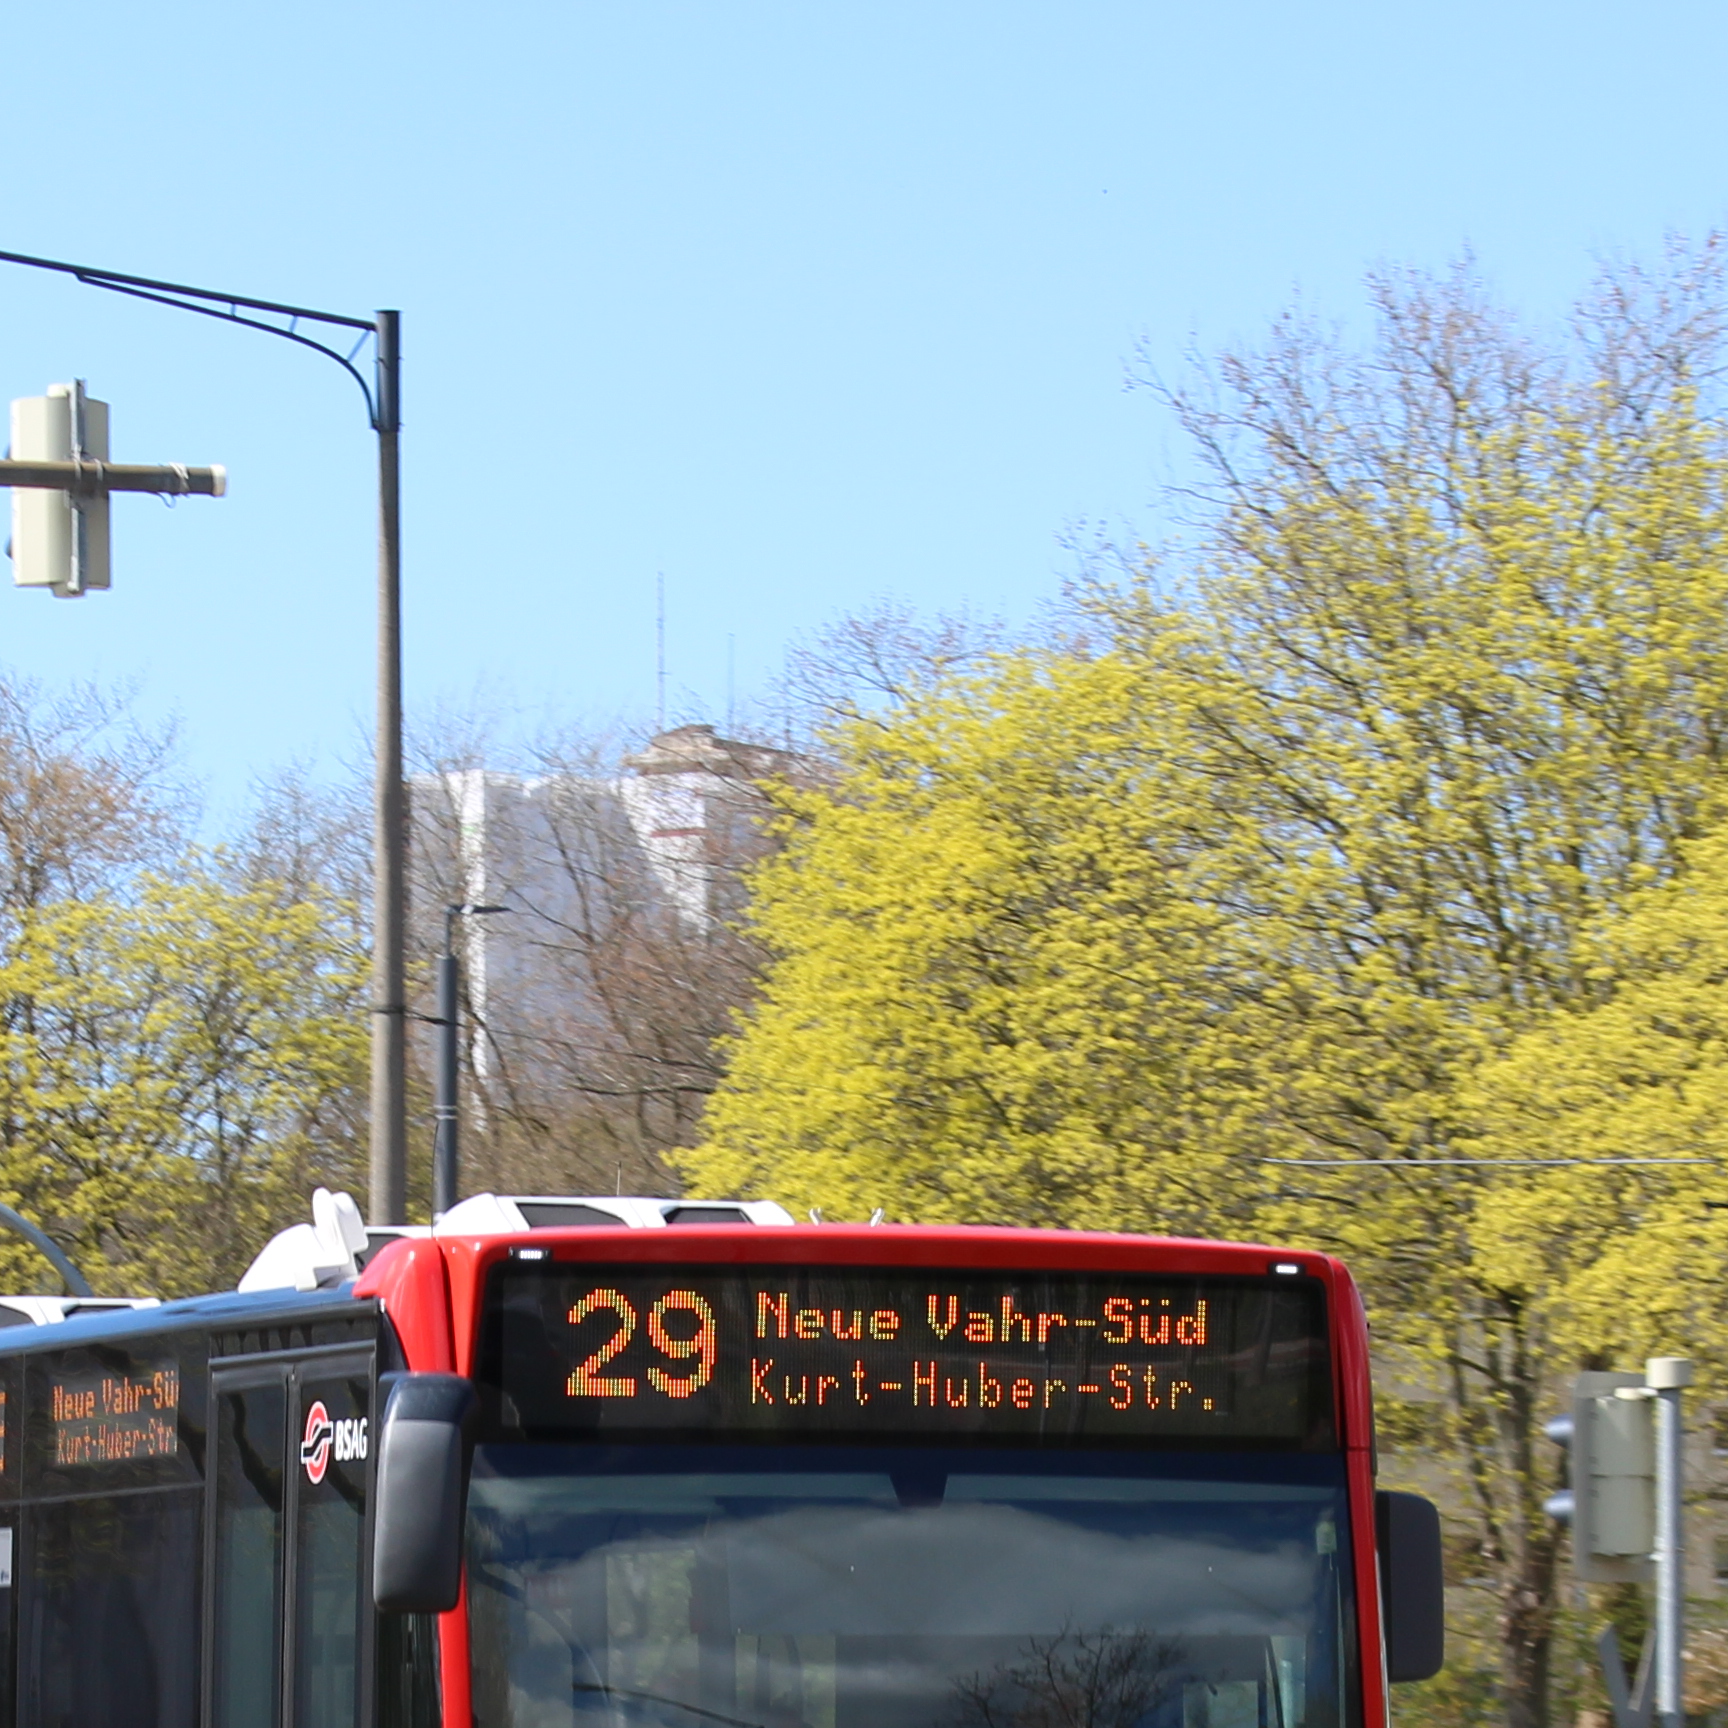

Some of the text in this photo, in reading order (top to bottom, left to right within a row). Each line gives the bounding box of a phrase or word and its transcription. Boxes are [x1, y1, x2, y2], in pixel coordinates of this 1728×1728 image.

[566, 1288, 717, 1398] 29
[756, 1291, 1207, 1345] Neue Vahr-Süd
[52, 1370, 179, 1422] Neue Vahr-Sü
[751, 1357, 1213, 1411] Kurt-Huber-Str.
[334, 1417, 368, 1462] BSAG
